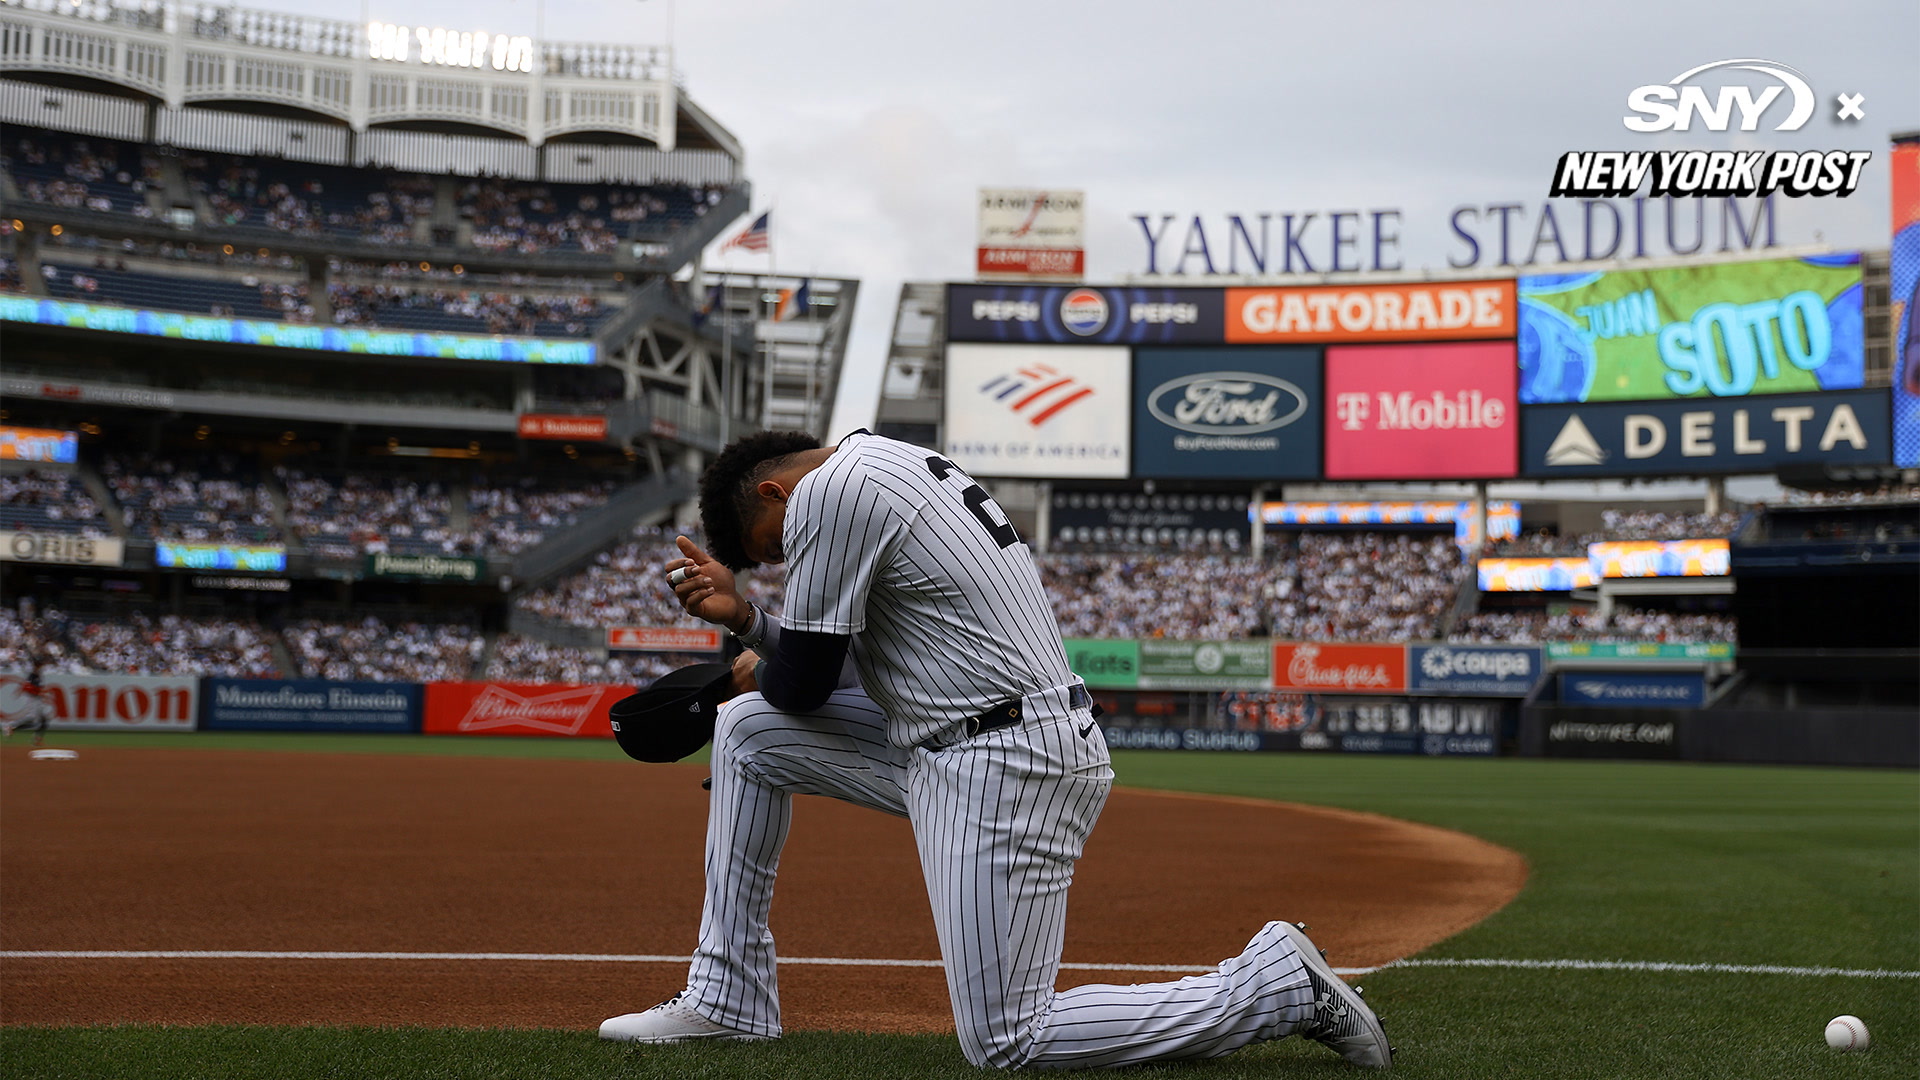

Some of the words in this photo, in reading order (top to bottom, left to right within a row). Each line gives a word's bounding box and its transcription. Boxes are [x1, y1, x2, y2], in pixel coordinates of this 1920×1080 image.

[1132, 208, 1403, 275] YANKEE
[1447, 196, 1779, 269] STADIUM
[972, 300, 1040, 321] PEPSI
[1130, 303, 1198, 324] PEPSI
[1242, 289, 1501, 332] GATORADE
[1575, 288, 1660, 343] JUAN
[1658, 290, 1832, 397] SOTO
[1175, 381, 1281, 424] Ford
[1378, 391, 1505, 429] Mobile
[1624, 403, 1868, 459] DELTA
[11, 532, 96, 563] ORIS
[1075, 651, 1133, 675] Eats
[1453, 652, 1530, 681] coupa
[216, 686, 327, 709] Montefiore
[328, 688, 408, 710] Einstein
